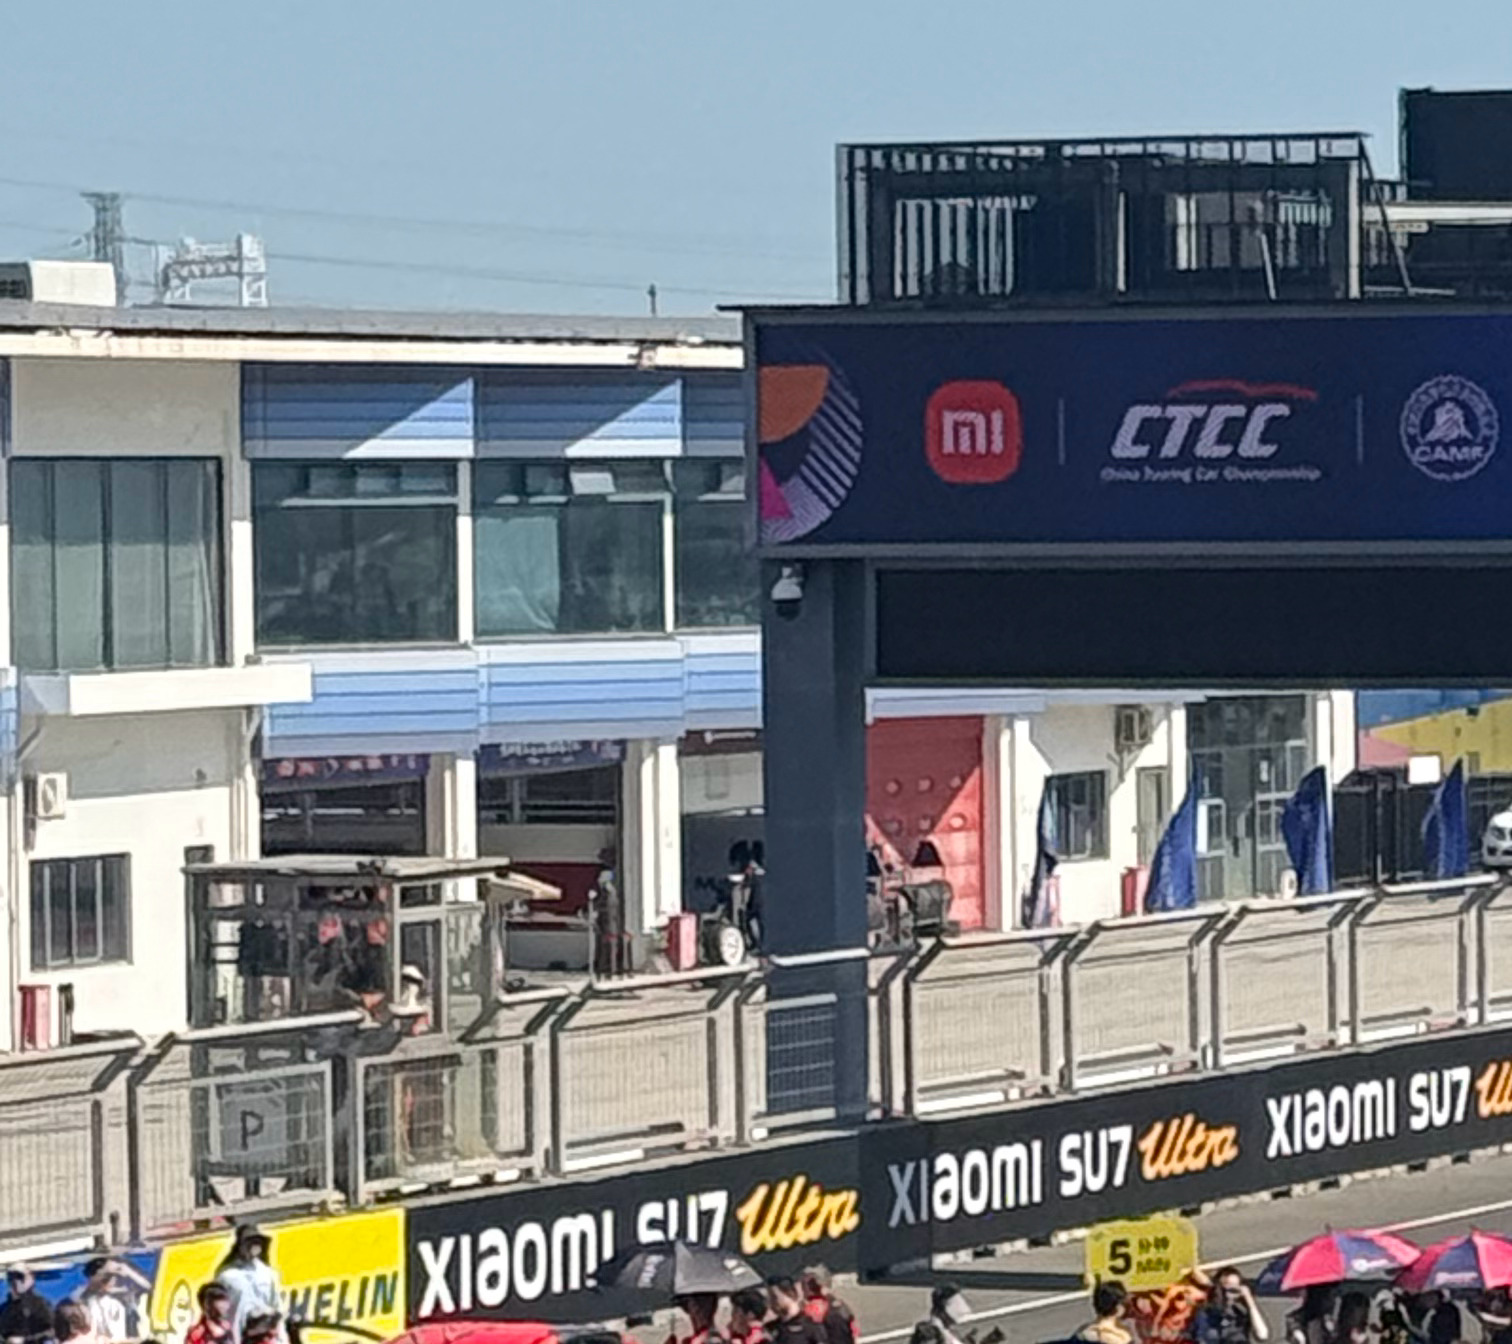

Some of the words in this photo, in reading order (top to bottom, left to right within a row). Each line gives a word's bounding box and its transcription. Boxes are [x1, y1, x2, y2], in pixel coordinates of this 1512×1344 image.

[1110, 403, 1291, 459] CTCC
[1408, 1065, 1472, 1132] SU7
[1058, 1124, 1134, 1198] SU7
[1137, 1112, 1239, 1181] Ultra
[735, 1173, 862, 1256] Ultra
[1108, 1238, 1132, 1276] 5
